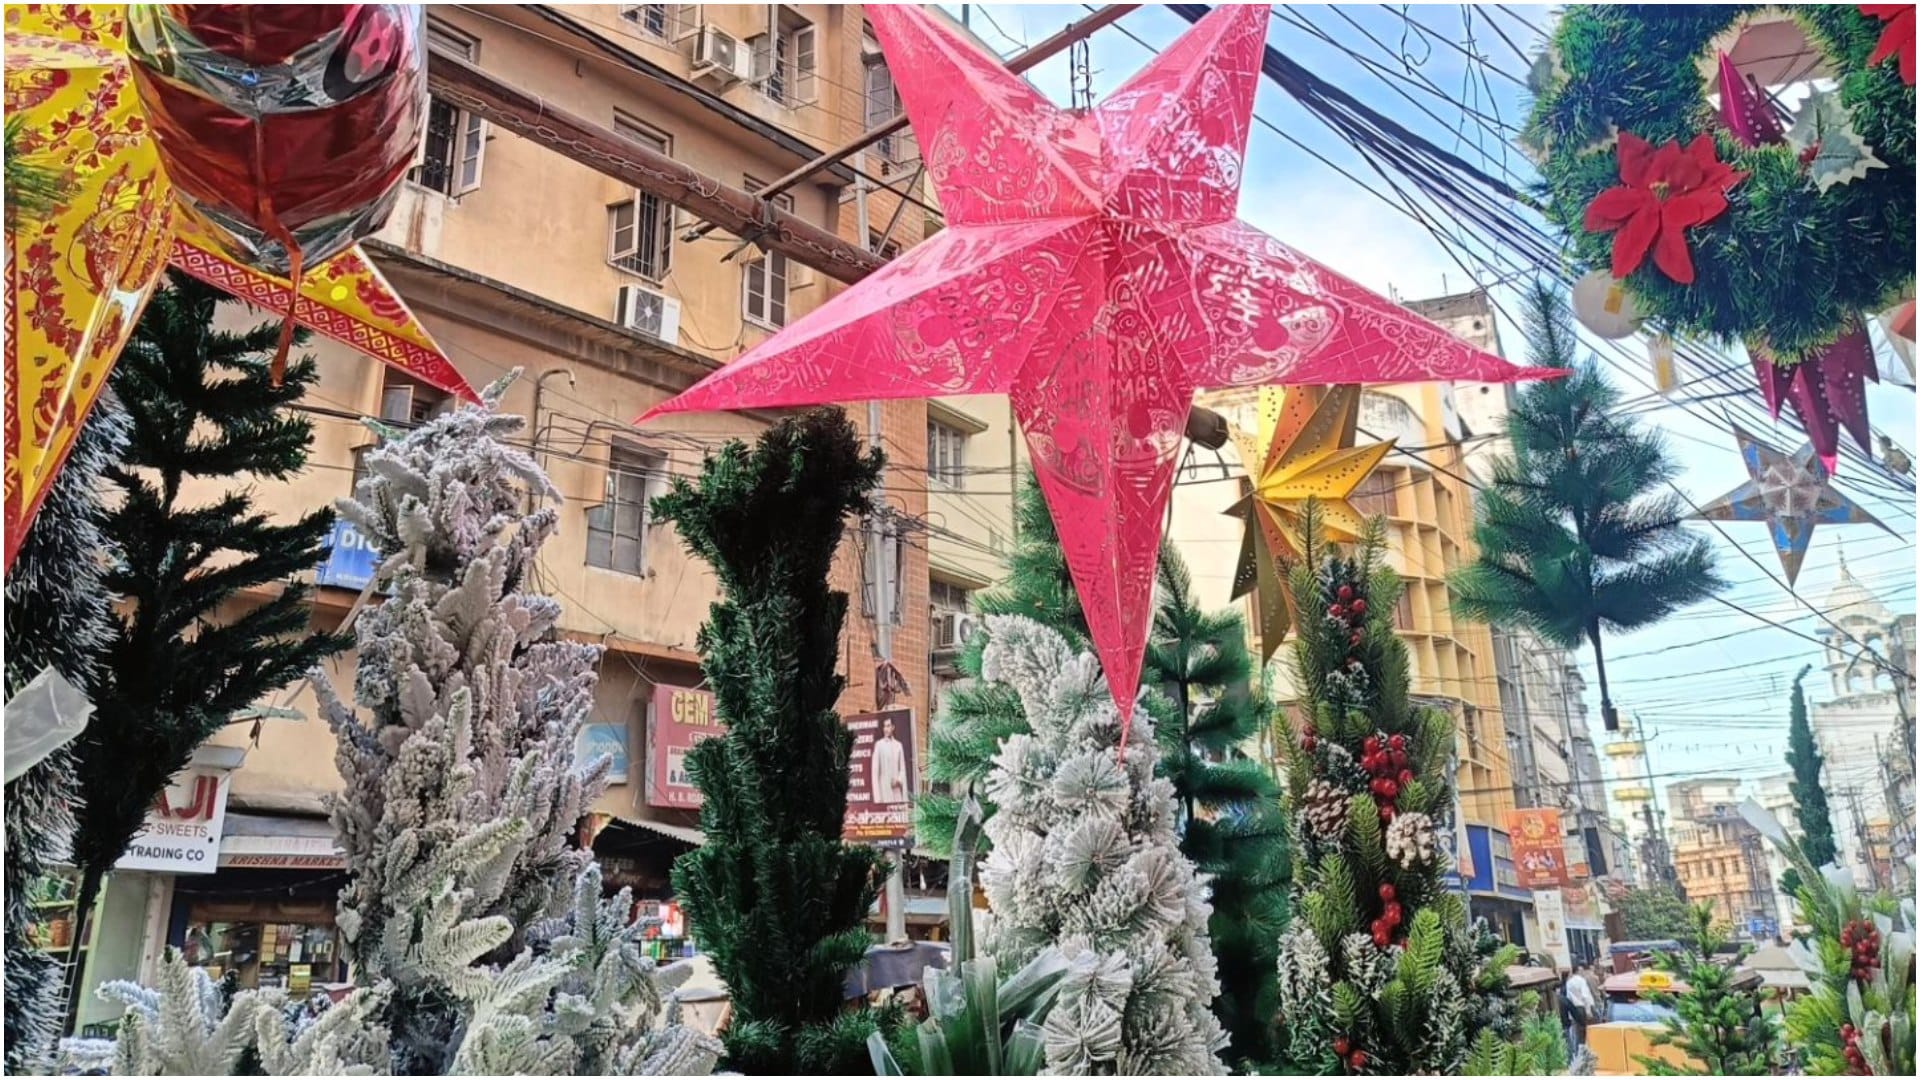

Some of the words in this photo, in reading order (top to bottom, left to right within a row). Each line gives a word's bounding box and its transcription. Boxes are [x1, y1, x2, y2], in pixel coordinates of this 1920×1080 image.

[671, 690, 709, 726] GEM
[152, 774, 218, 820] AJI
[156, 823, 208, 838] SWEETS
[130, 844, 182, 860] TRADING
[186, 849, 205, 861] CO
[228, 854, 288, 866] KRISHNA
[290, 854, 345, 866] MARKET
